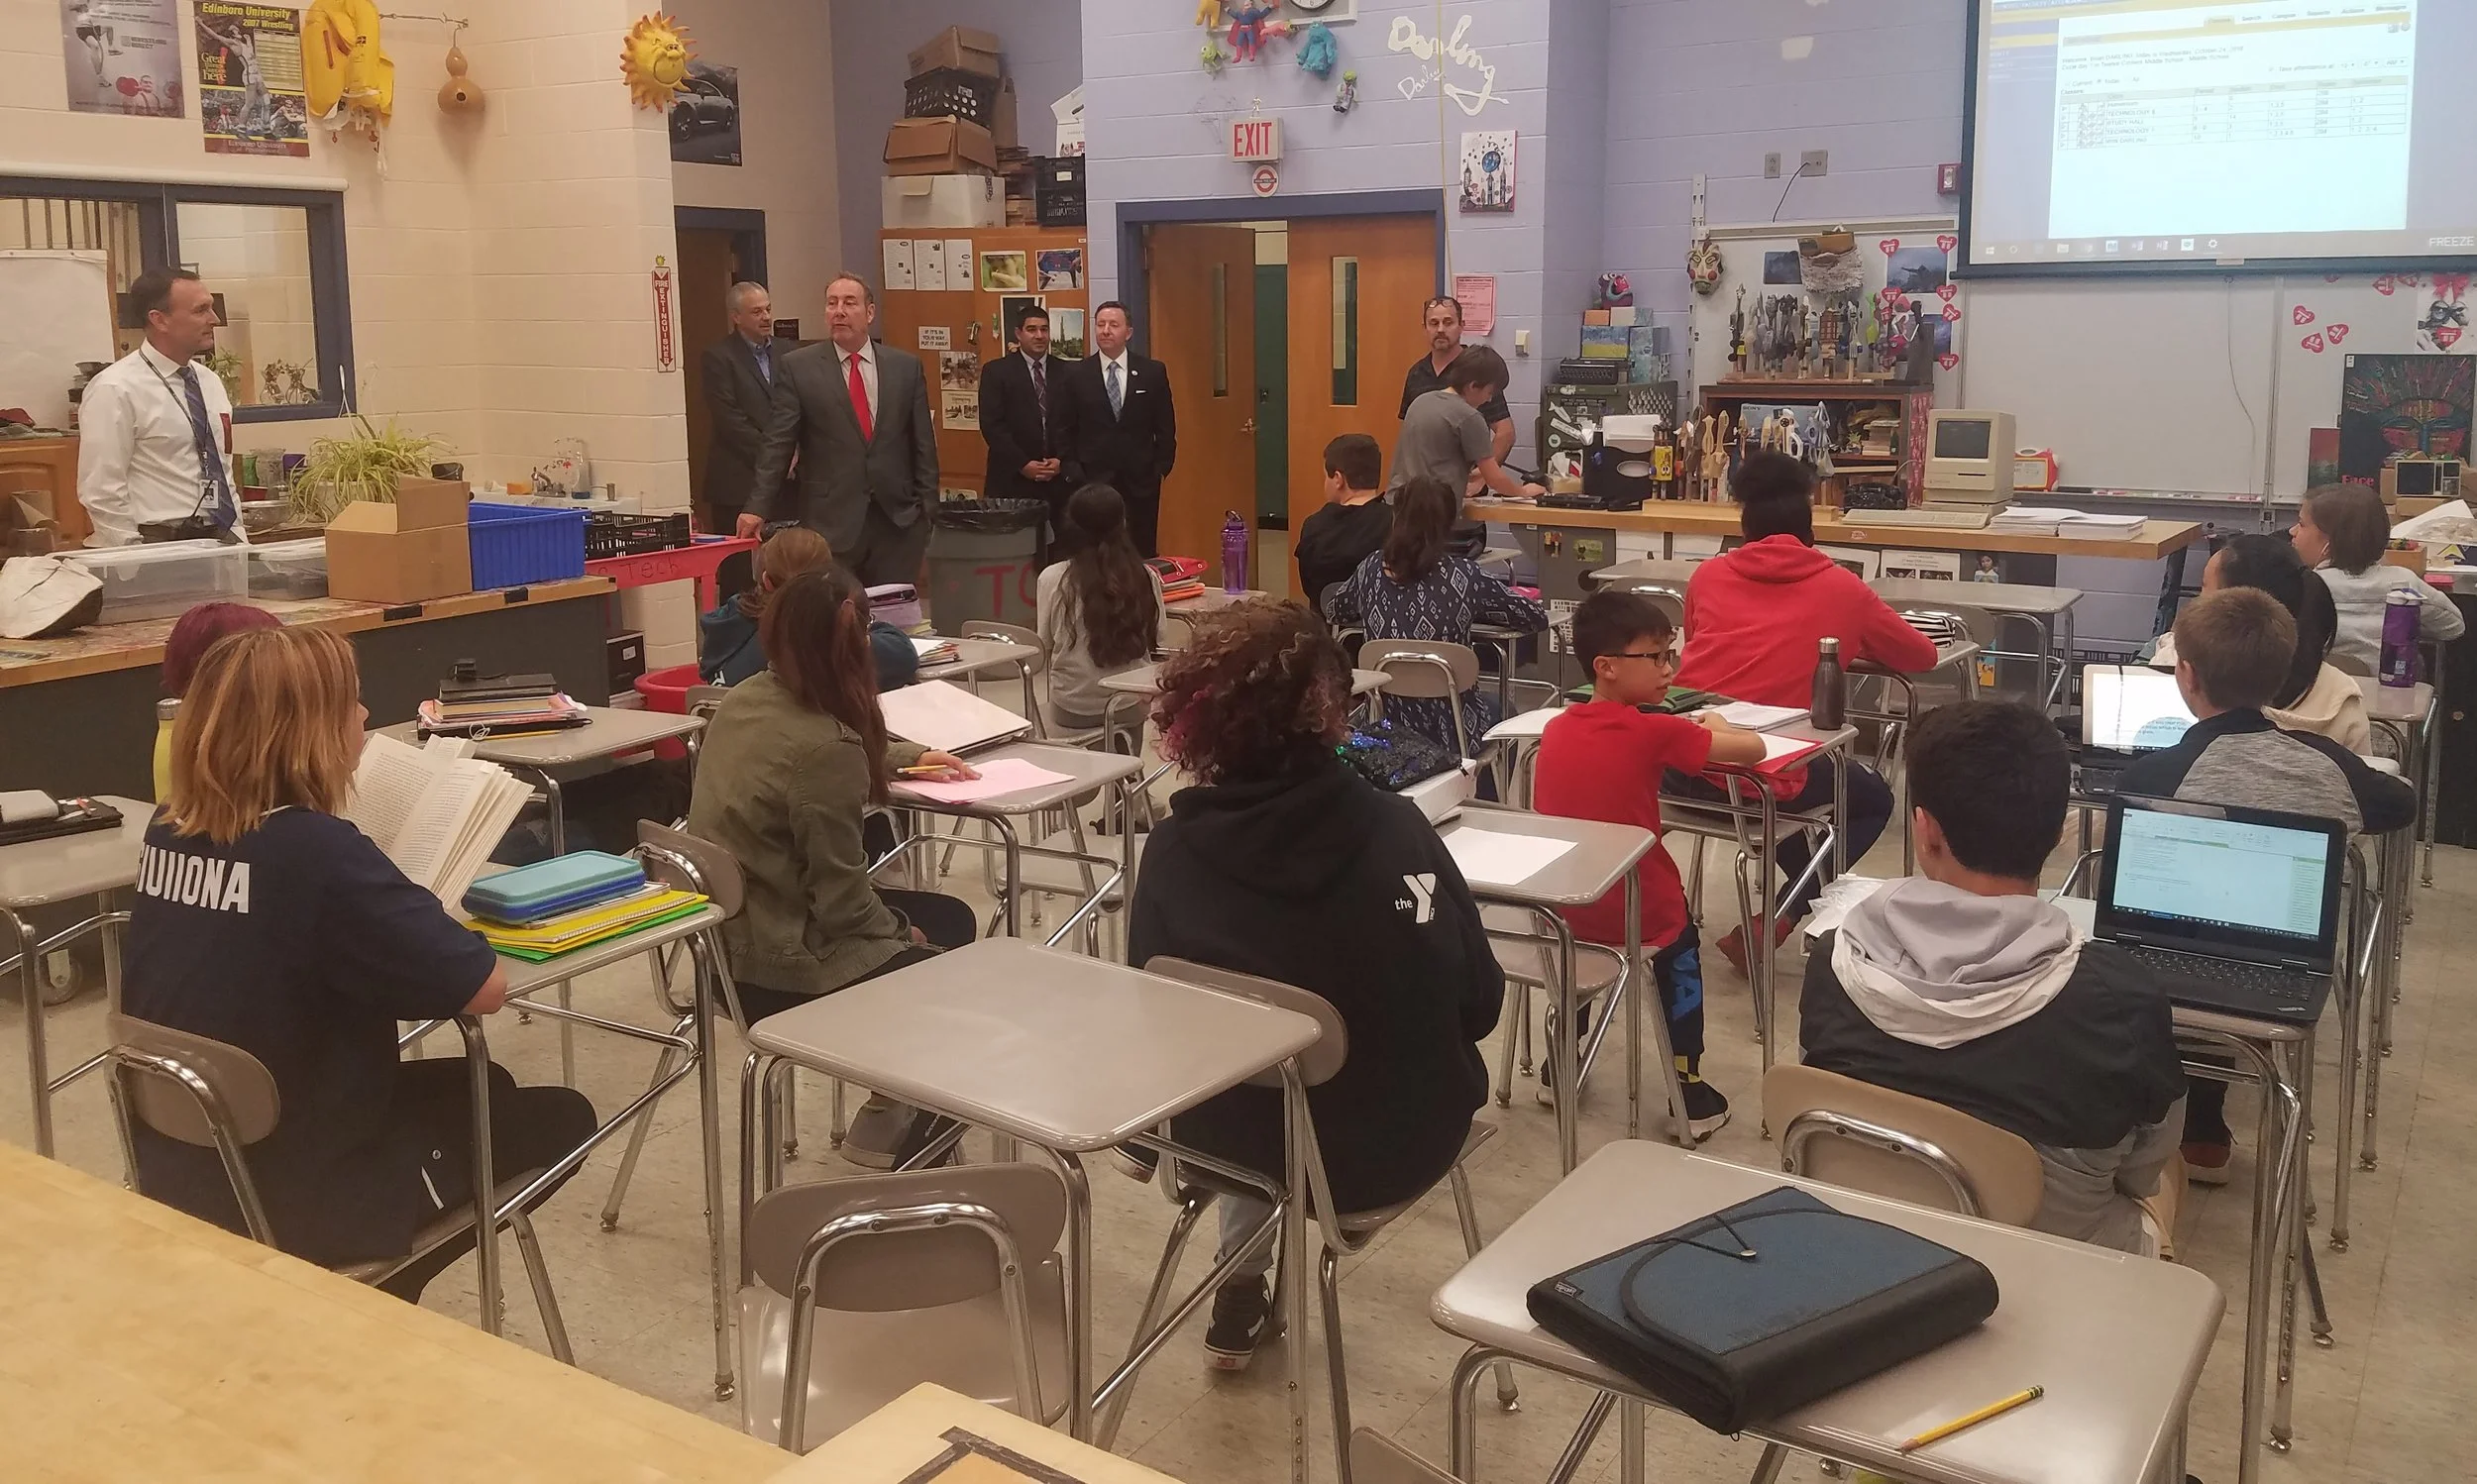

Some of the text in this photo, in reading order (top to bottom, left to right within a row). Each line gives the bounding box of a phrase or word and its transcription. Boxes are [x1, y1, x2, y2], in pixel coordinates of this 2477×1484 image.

[202, 2, 291, 20] Edinboro University
[261, 19, 294, 31] Wrestling
[201, 52, 227, 64] Great
[202, 69, 227, 81] here
[1235, 122, 1272, 157] EXIT
[2429, 236, 2475, 248] FREEZE
[659, 287, 671, 364] EXTINGUISHER
[1394, 873, 1437, 924] the Y
